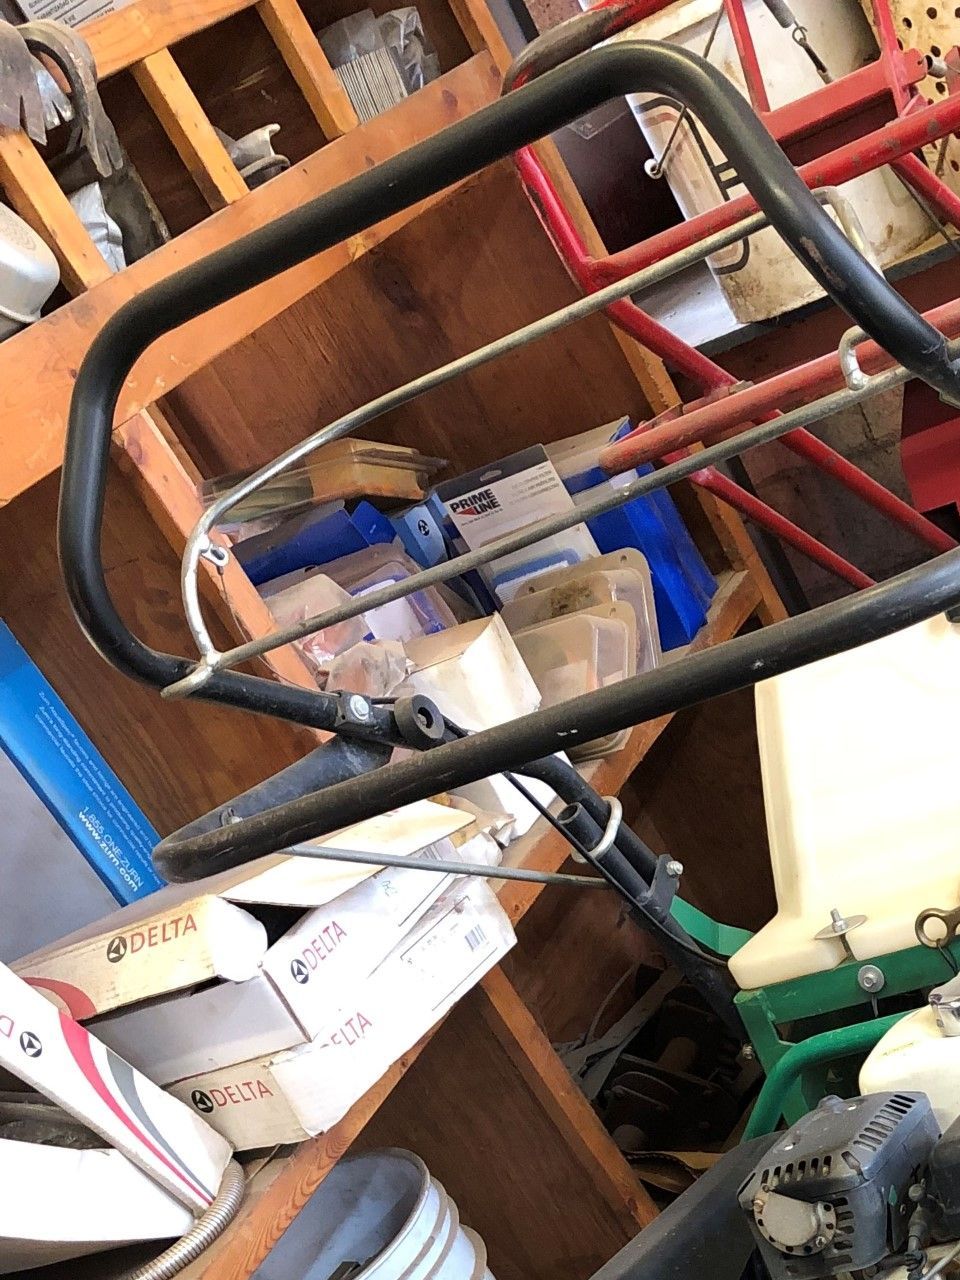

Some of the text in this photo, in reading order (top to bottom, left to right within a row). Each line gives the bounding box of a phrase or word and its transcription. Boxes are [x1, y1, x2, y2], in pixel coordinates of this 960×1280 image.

[450, 488, 496, 514] PRIME
[475, 499, 501, 515] LINE
[78, 811, 138, 893] www.zurn.com
[130, 913, 198, 954] DELTA
[302, 921, 347, 970] DELTA
[209, 1079, 274, 1107] DELTA
